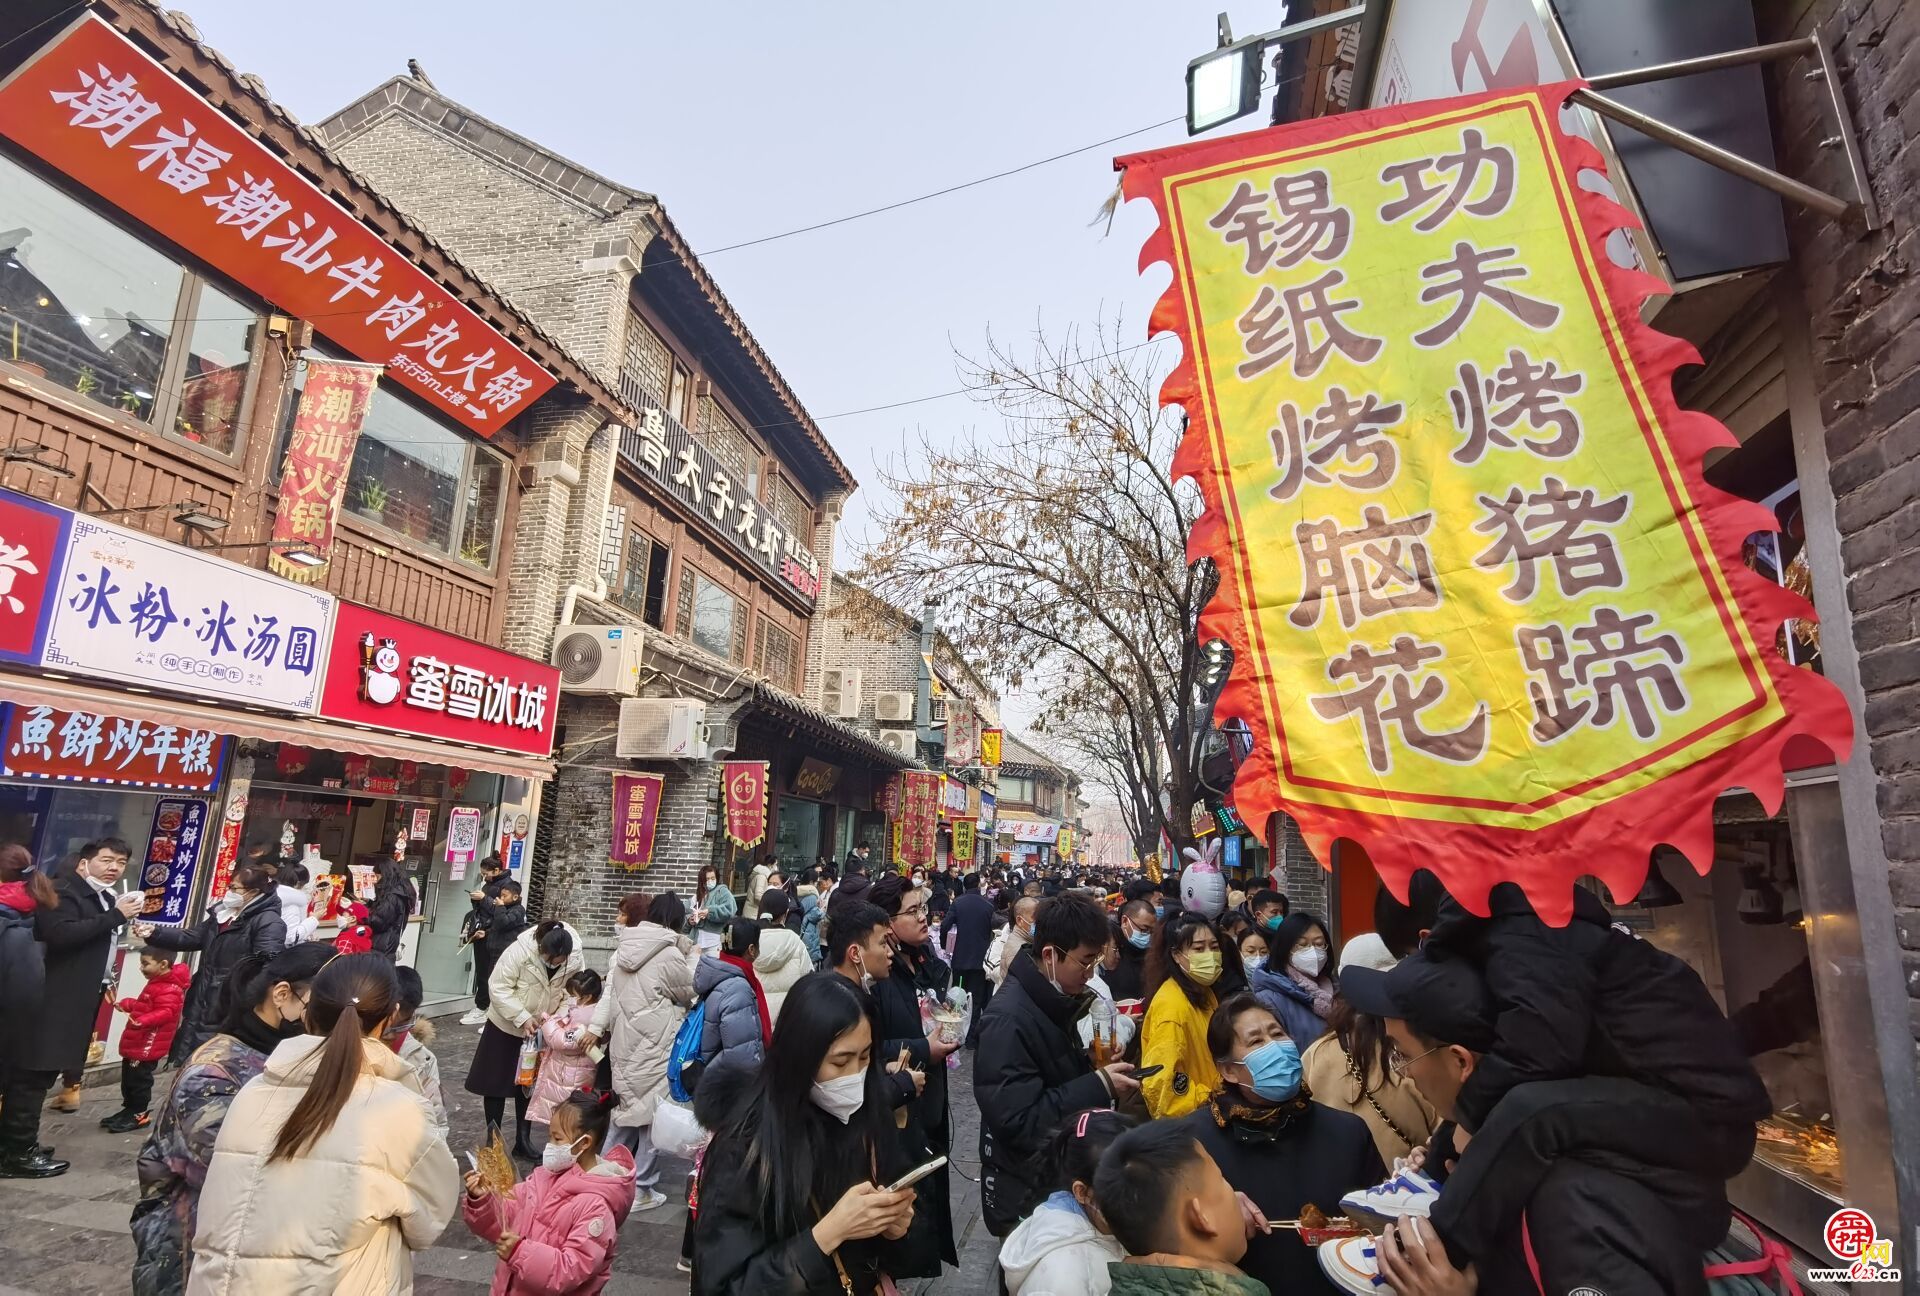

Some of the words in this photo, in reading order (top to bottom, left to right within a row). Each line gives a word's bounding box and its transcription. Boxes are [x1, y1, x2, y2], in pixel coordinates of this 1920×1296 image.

[49, 62, 534, 414] 潮福潮汕牛肉丸火锅
[389, 352, 469, 407] 东行5m上楼
[290, 386, 354, 539] 潮汕火锅
[1207, 167, 1491, 777] 锡纸烤脑花
[1380, 126, 1692, 744] 功夫烤猪蹄
[639, 408, 780, 566] 鲁太子龙虾
[164, 656, 240, 680] 纯手工制作
[406, 655, 548, 732] 蜜雪冰城
[11, 706, 217, 776] 魚餅炒年糕
[165, 804, 200, 918] 魚餅炒年糕
[624, 784, 647, 855] 蜜雪冰城
[911, 782, 930, 853] 潮汕火锅
